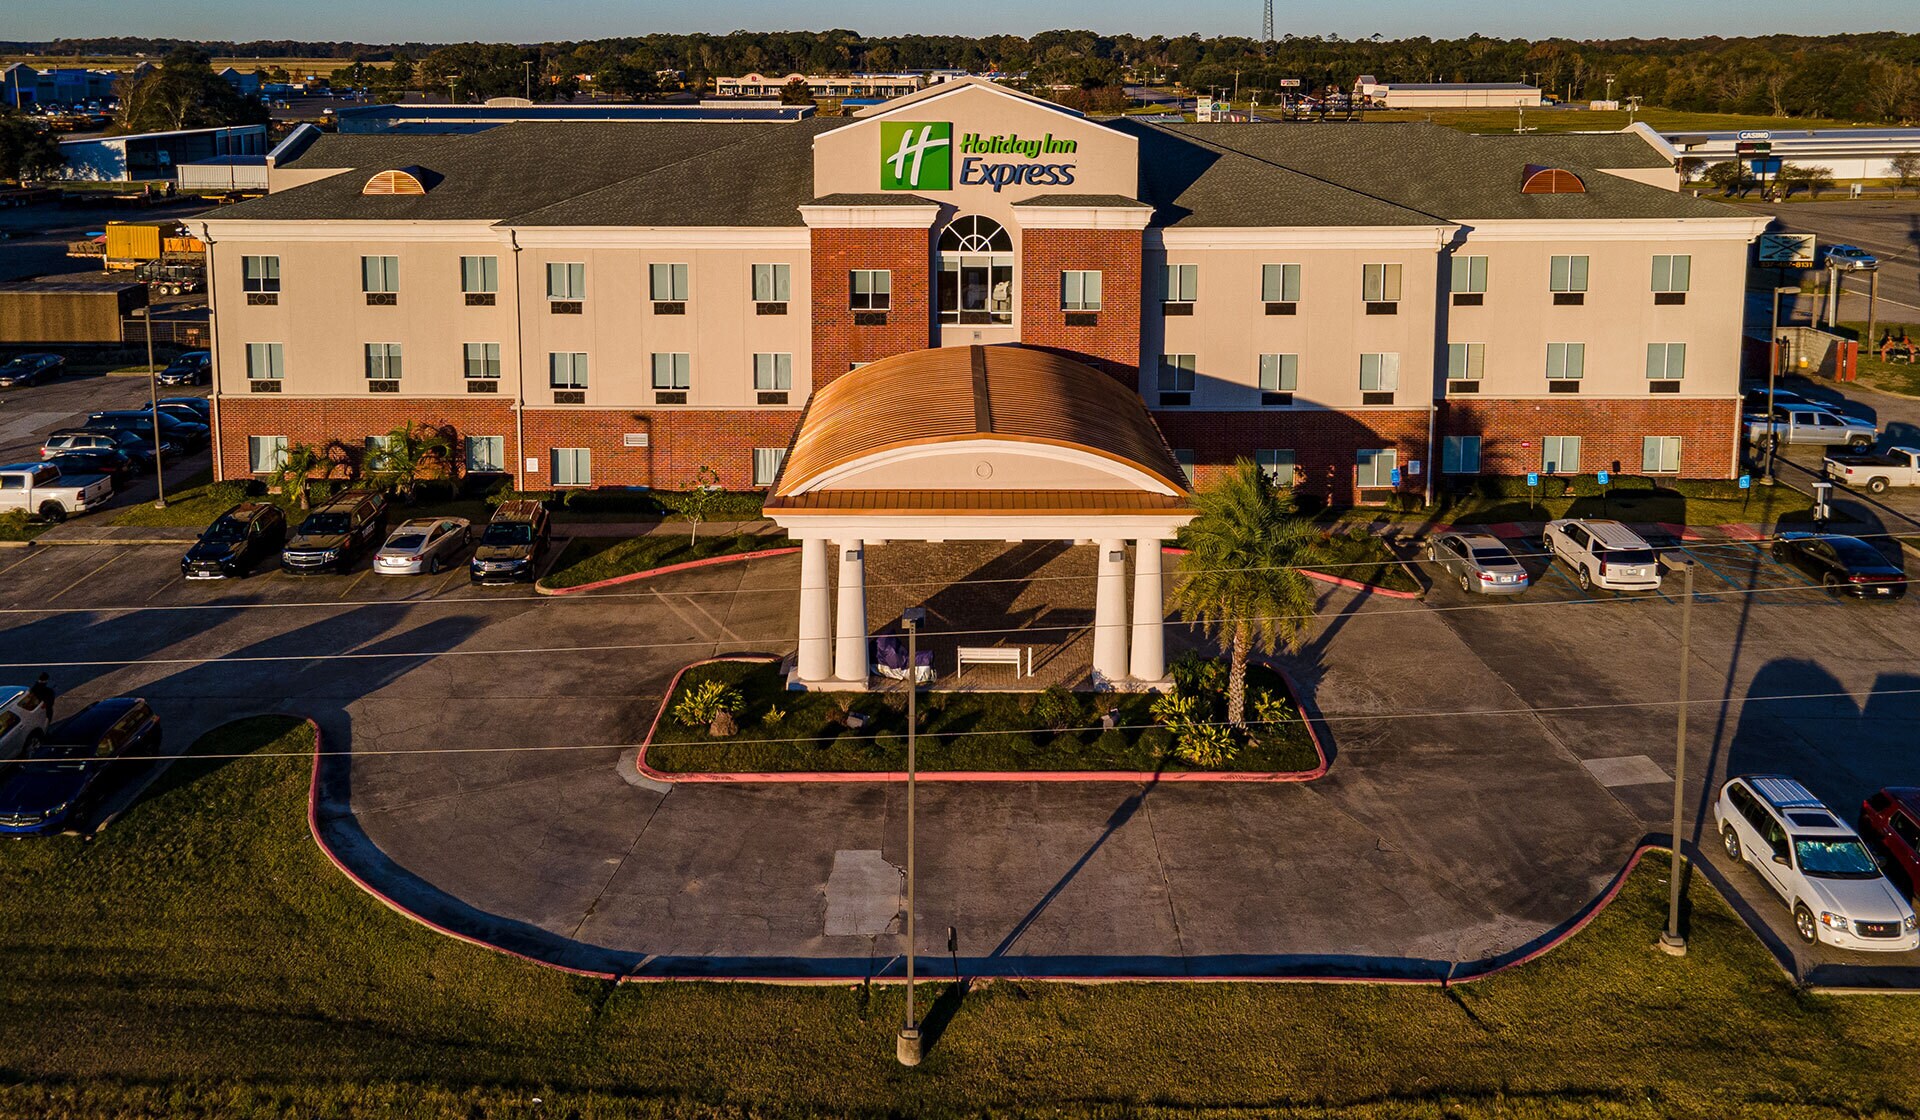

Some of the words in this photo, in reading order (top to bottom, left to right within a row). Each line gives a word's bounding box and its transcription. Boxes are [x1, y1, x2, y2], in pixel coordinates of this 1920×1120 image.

[959, 133, 1041, 158] Holiday
[1042, 133, 1077, 154] Inn
[959, 157, 1076, 192] Express
